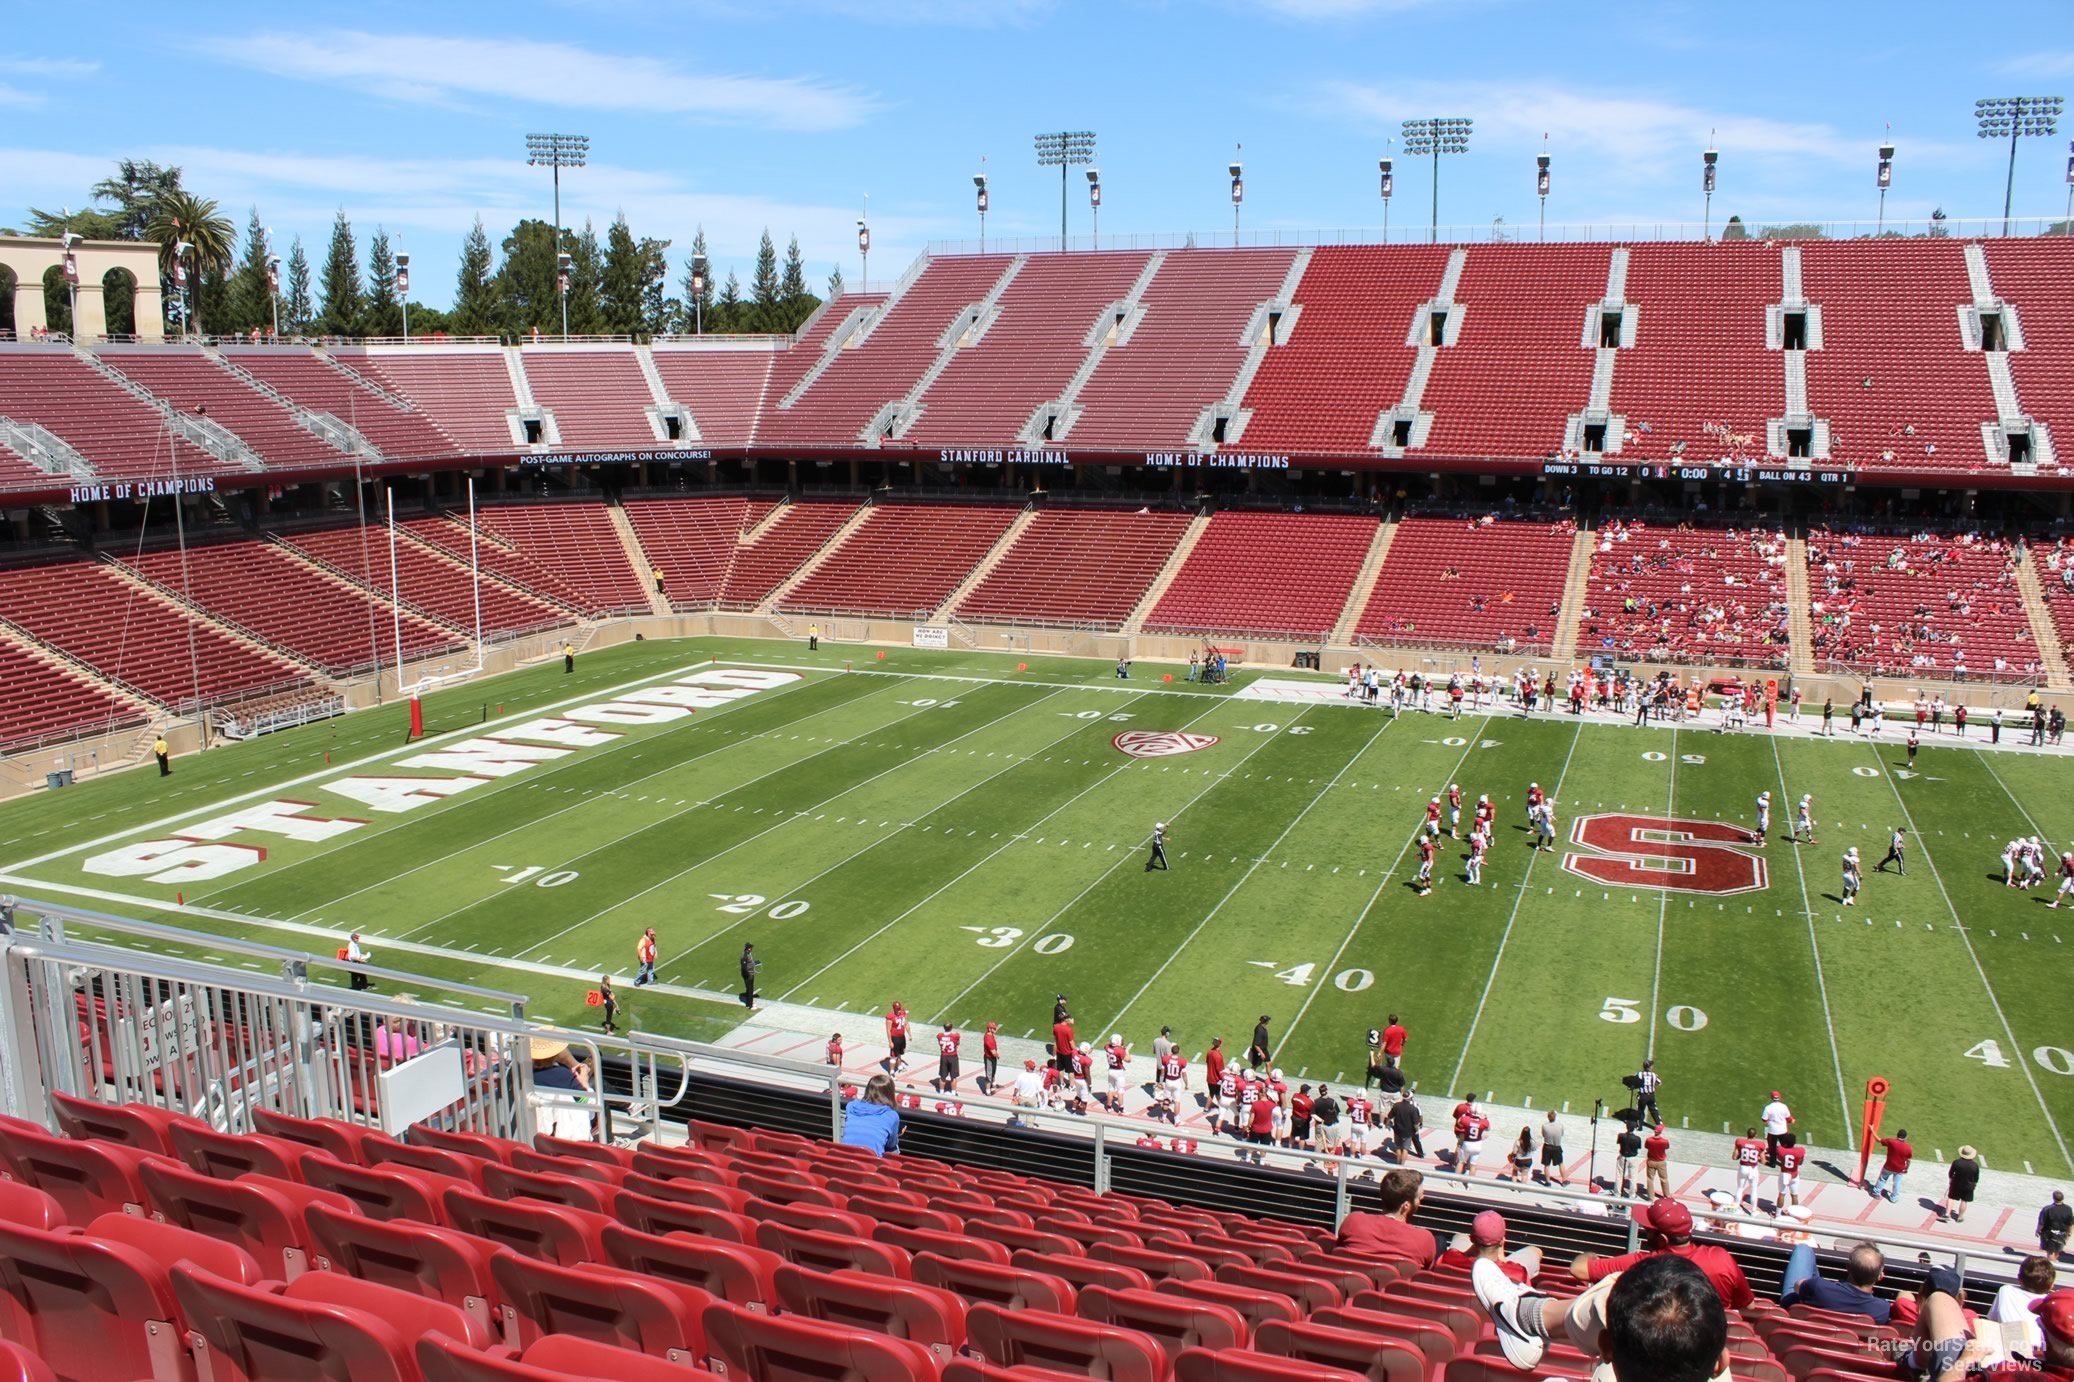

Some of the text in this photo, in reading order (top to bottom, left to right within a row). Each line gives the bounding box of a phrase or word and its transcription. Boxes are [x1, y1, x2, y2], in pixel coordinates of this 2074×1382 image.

[520, 450, 711, 464] POST-GAME AUTOGRAPHS ON CONCOURSE!
[940, 450, 1069, 464] STANFORD CARDINAL
[1146, 453, 1289, 468] HOME OF CHAMPIONS
[1545, 464, 1577, 474] DOWN 3
[1589, 465, 1628, 476] TO GO 12
[1642, 467, 1649, 477] 0
[1681, 468, 1708, 479] 0:00
[1723, 469, 1731, 479] 4
[1759, 471, 1780, 480] BALL
[1783, 472, 1796, 481] ON
[1798, 472, 1812, 481] 43
[1821, 472, 1847, 482] QTR 1
[70, 477, 214, 502] HOME OF CHAMPIONS
[1442, 736, 1504, 749] 40
[1641, 751, 1707, 765] 50
[82, 668, 805, 884] STANFORD
[1561, 812, 1769, 896] S
[499, 866, 580, 887] 10
[715, 894, 811, 919] 20
[976, 927, 1075, 955] 30
[1274, 962, 1376, 992] 40
[587, 992, 598, 1004] 20
[1599, 997, 1708, 1031] 50
[1370, 1029, 1380, 1043] 3
[940, 1041, 955, 1053] 73
[1963, 1038, 2074, 1075] 40
[1166, 1064, 1180, 1077] 10
[1243, 1090, 1259, 1104] 26
[1351, 1108, 1365, 1122] 41
[1469, 1127, 1479, 1139] 9
[1740, 1149, 1759, 1162] 89
[1784, 1155, 1795, 1168] 6
